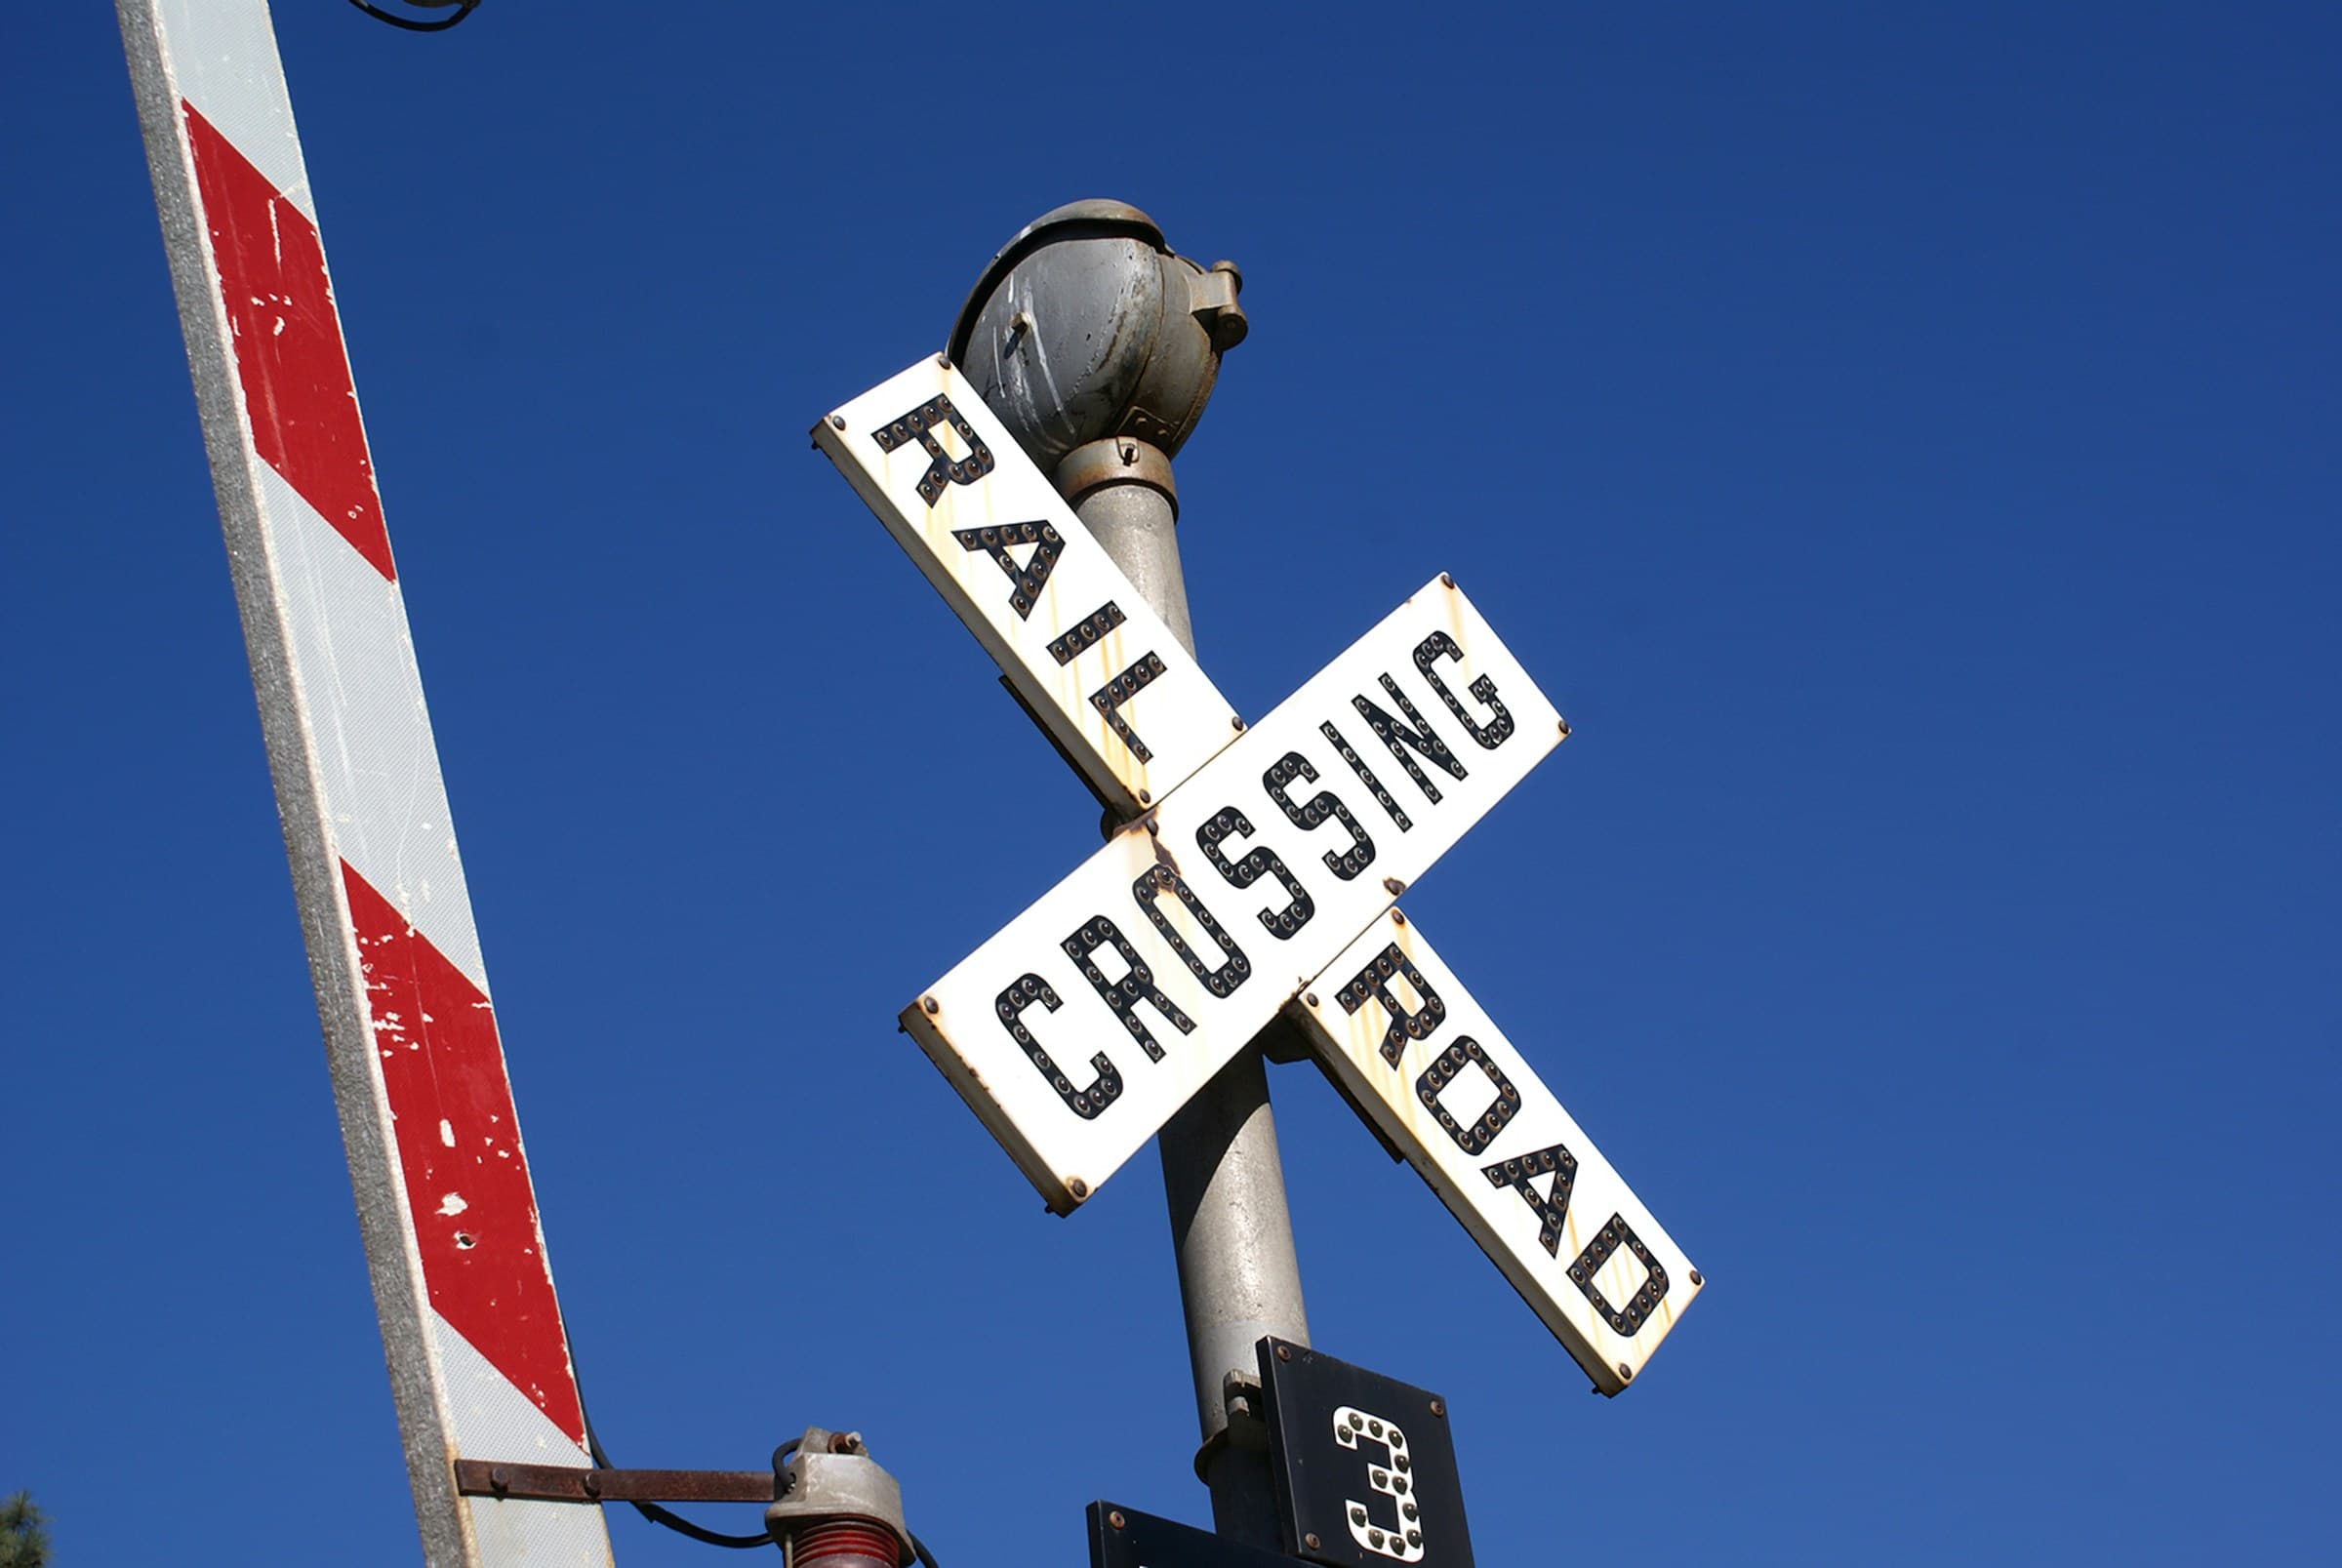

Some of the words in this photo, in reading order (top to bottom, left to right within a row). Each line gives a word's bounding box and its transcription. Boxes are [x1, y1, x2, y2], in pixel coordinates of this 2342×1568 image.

[870, 392, 1167, 765] RAIL
[995, 630, 1514, 1120] CROSSING
[1335, 942, 1669, 1337] ROAD
[1333, 1406, 1425, 1563] 3
